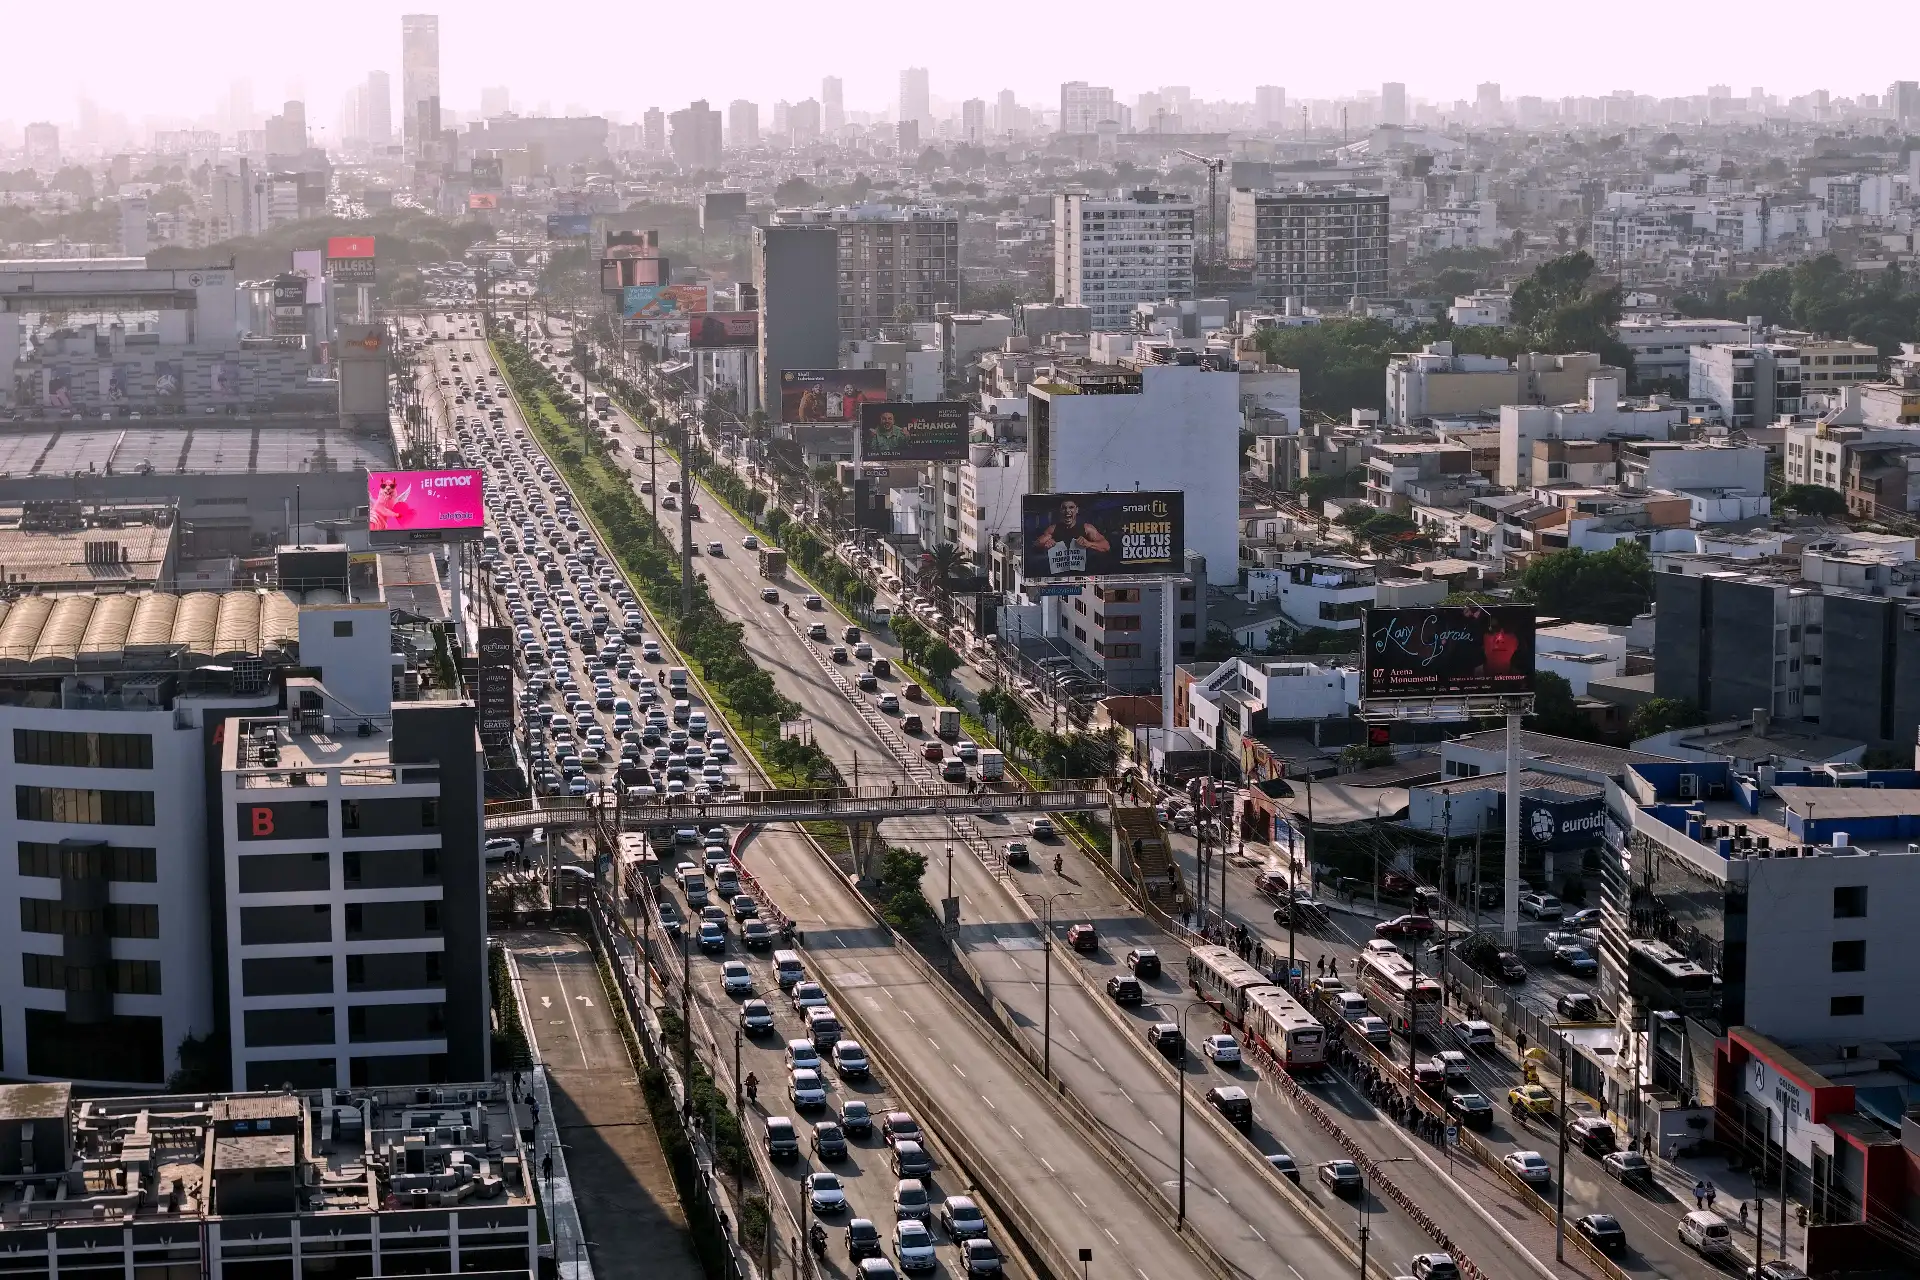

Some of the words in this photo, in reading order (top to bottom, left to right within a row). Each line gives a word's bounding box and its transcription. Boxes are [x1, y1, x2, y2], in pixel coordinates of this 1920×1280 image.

[907, 422, 957, 431] PICHANGA
[434, 475, 472, 487] amor
[1122, 504, 1151, 512] smart
[1152, 500, 1167, 513] fit
[1122, 521, 1171, 533] +FUERTE
[1121, 535, 1146, 547] QUE
[1150, 533, 1171, 545] TUS
[1122, 546, 1171, 559] EXCUSAS
[1372, 617, 1418, 656] Kany
[1373, 668, 1385, 678] 07
[1390, 668, 1413, 676] Arena
[1390, 674, 1438, 684] Monumental
[252, 807, 275, 836] B
[1779, 1077, 1800, 1097] COLEGIO
